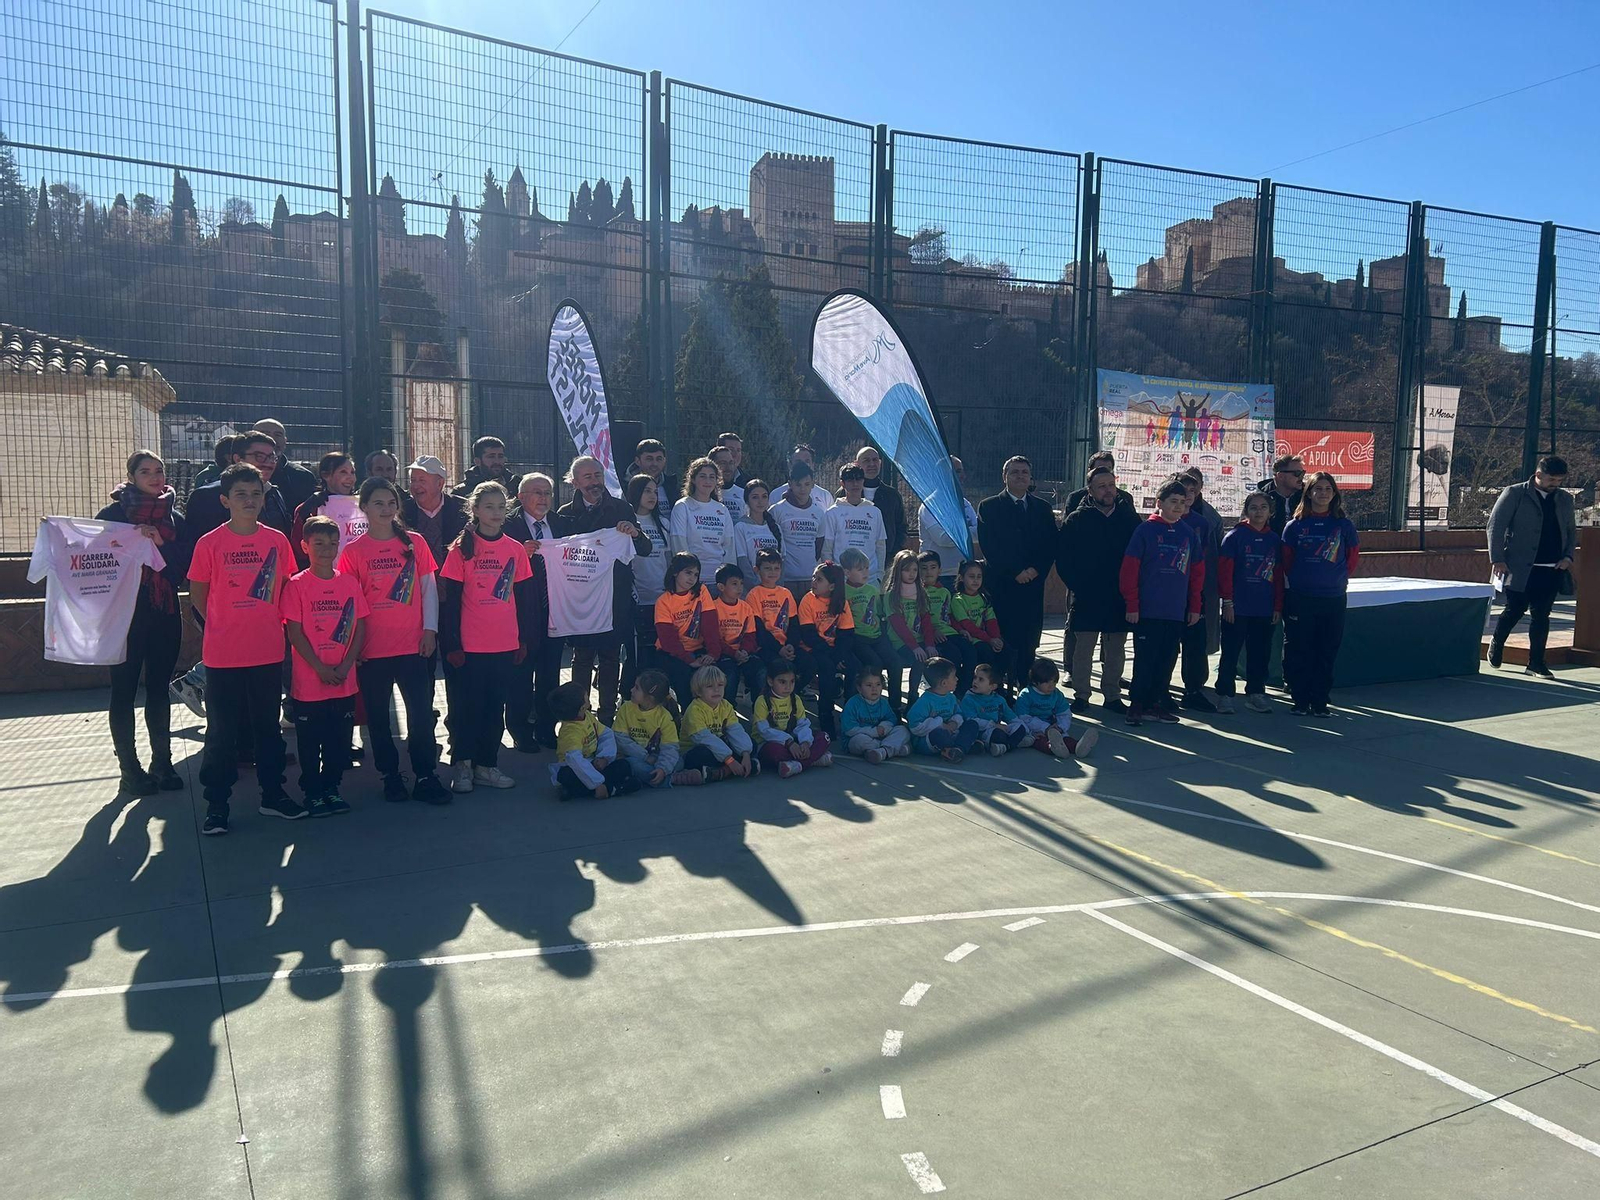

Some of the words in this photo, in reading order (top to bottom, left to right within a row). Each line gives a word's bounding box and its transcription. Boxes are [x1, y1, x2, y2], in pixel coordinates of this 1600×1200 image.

[1100, 408, 1123, 419] omega
[1308, 450, 1337, 467] APOLO
[231, 550, 259, 558] CARRERA
[562, 546, 571, 560] XI
[571, 547, 596, 556] CARRERA
[81, 552, 114, 562] CARRERA
[231, 557, 264, 565] SOLIDARIA
[372, 557, 398, 565] CARRERA
[570, 554, 600, 563] SOLIDARIA
[70, 554, 82, 571] XI
[81, 559, 121, 570] SOLIDARIA
[372, 562, 402, 571] SOLIDARIA
[96, 569, 118, 577] GRANADA
